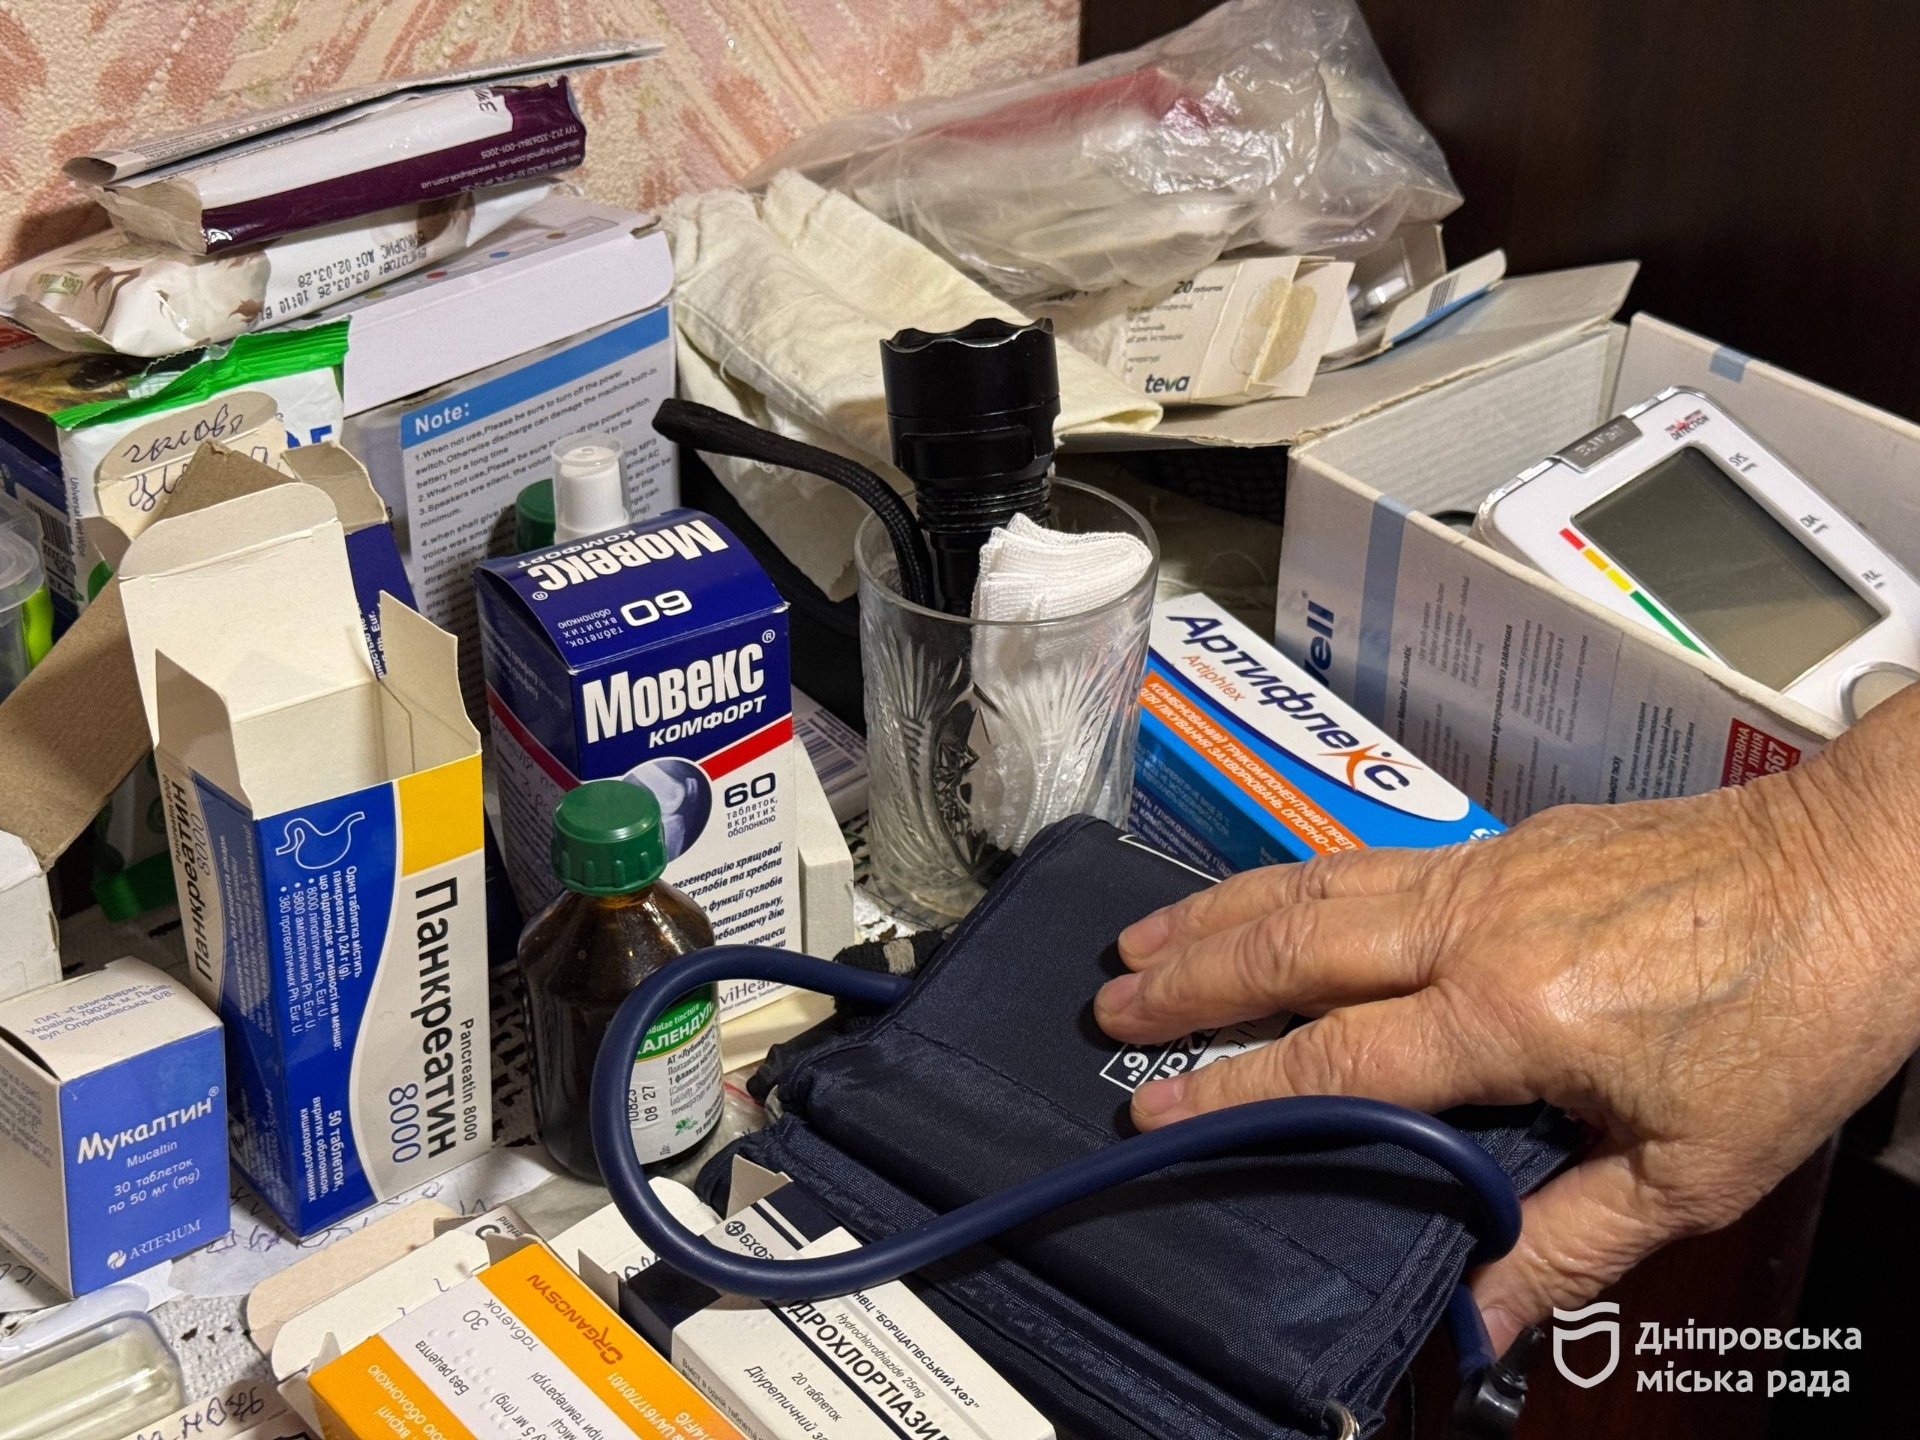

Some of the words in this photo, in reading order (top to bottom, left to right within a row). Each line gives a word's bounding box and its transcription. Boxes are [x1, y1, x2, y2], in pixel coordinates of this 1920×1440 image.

[1173, 279, 1193, 295] 20
[1144, 372, 1190, 395] teva
[415, 403, 469, 434] Note:
[1671, 415, 1710, 441] DETECTION
[517, 530, 636, 569] КОМФОРТ
[558, 608, 611, 628] оболонкою
[620, 590, 692, 626] 60
[563, 617, 618, 638] вкритих
[566, 626, 624, 647] таблеток,
[1305, 600, 1336, 687] ell
[1500, 623, 1512, 670] давления
[1182, 655, 1245, 701] Artiphlex
[649, 695, 766, 748] КОМФОРТ
[1146, 682, 1227, 744] КОМБІНОВАНИЙ
[1222, 742, 1327, 825] ТРИКОМПОНЕНТНИЙ
[1154, 699, 1217, 747] ЛІКУВАННЯ
[1207, 747, 1287, 808] ЗАХВОРЮВАНЬ
[724, 772, 776, 808] 60
[726, 797, 778, 820] таблеток,
[727, 807, 776, 829] вкритих
[190, 812, 215, 875] 8000
[727, 815, 776, 838] оболонкою
[736, 842, 783, 869] хрящової
[172, 782, 212, 981] Панкреатин
[318, 874, 328, 890] що
[345, 865, 356, 893] Одна
[688, 877, 728, 901] суглобів
[730, 872, 745, 882] та
[747, 857, 782, 878] хребта
[709, 888, 744, 912] функції
[745, 875, 783, 901] суглобів
[278, 894, 291, 913] 380
[292, 891, 305, 915] 5800
[306, 886, 319, 910] 8000
[332, 870, 345, 933] панкреатину
[767, 906, 785, 922] дію
[320, 891, 333, 946] відповідає
[348, 893, 359, 939] таблетка
[280, 914, 295, 987] протеолітичних
[337, 934, 349, 955] 0,24
[352, 939, 362, 977] містить
[301, 982, 312, 999] Ph.
[314, 971, 325, 988] Ph.
[325, 948, 339, 1000] активності
[287, 987, 299, 1004] Ph.
[302, 999, 314, 1019] Eur.
[315, 988, 326, 1008] Eur.
[330, 1001, 338, 1014] не
[33, 1011, 60, 1024] ПАТ
[289, 1004, 300, 1024] Eur.
[416, 882, 454, 1156] Панкреатин
[674, 1004, 700, 1023] tinctura
[331, 1015, 342, 1050] менше:
[460, 1018, 474, 1103] Pancreatin
[642, 1086, 656, 1099] 27
[312, 1096, 323, 1137] вкритих
[328, 1110, 341, 1126] 50
[388, 1083, 420, 1162] 8000
[463, 1105, 477, 1140] 8000
[644, 1106, 658, 1122] 08
[127, 1141, 177, 1167] Mucaltin
[300, 1107, 316, 1202] кишковорозчинних
[316, 1138, 328, 1197] оболонкою,
[329, 1127, 343, 1191] таблеток,
[108, 1201, 125, 1213] по
[130, 1189, 146, 1204] 50
[152, 1183, 168, 1196] мг
[173, 1168, 199, 1188] (mg)
[114, 1181, 130, 1196] 30
[136, 1158, 192, 1186] таблеток
[130, 1219, 200, 1259] ARTERIUM
[462, 1309, 488, 1330] 30
[483, 1296, 538, 1351] таблеток
[415, 1340, 454, 1376] рецепта
[835, 1313, 904, 1377] Hydrochlorothiazide
[901, 1376, 925, 1398] 25mg
[367, 1364, 426, 1424] оболонкою
[448, 1374, 469, 1395] Без
[530, 1372, 585, 1425] температурі
[743, 1366, 817, 1431] Діуретичний
[791, 1372, 807, 1385] 20
[803, 1384, 841, 1422] таблеток
[490, 1392, 519, 1416] (mg)
[512, 1415, 528, 1427] мг
[521, 1426, 535, 1436] 5
